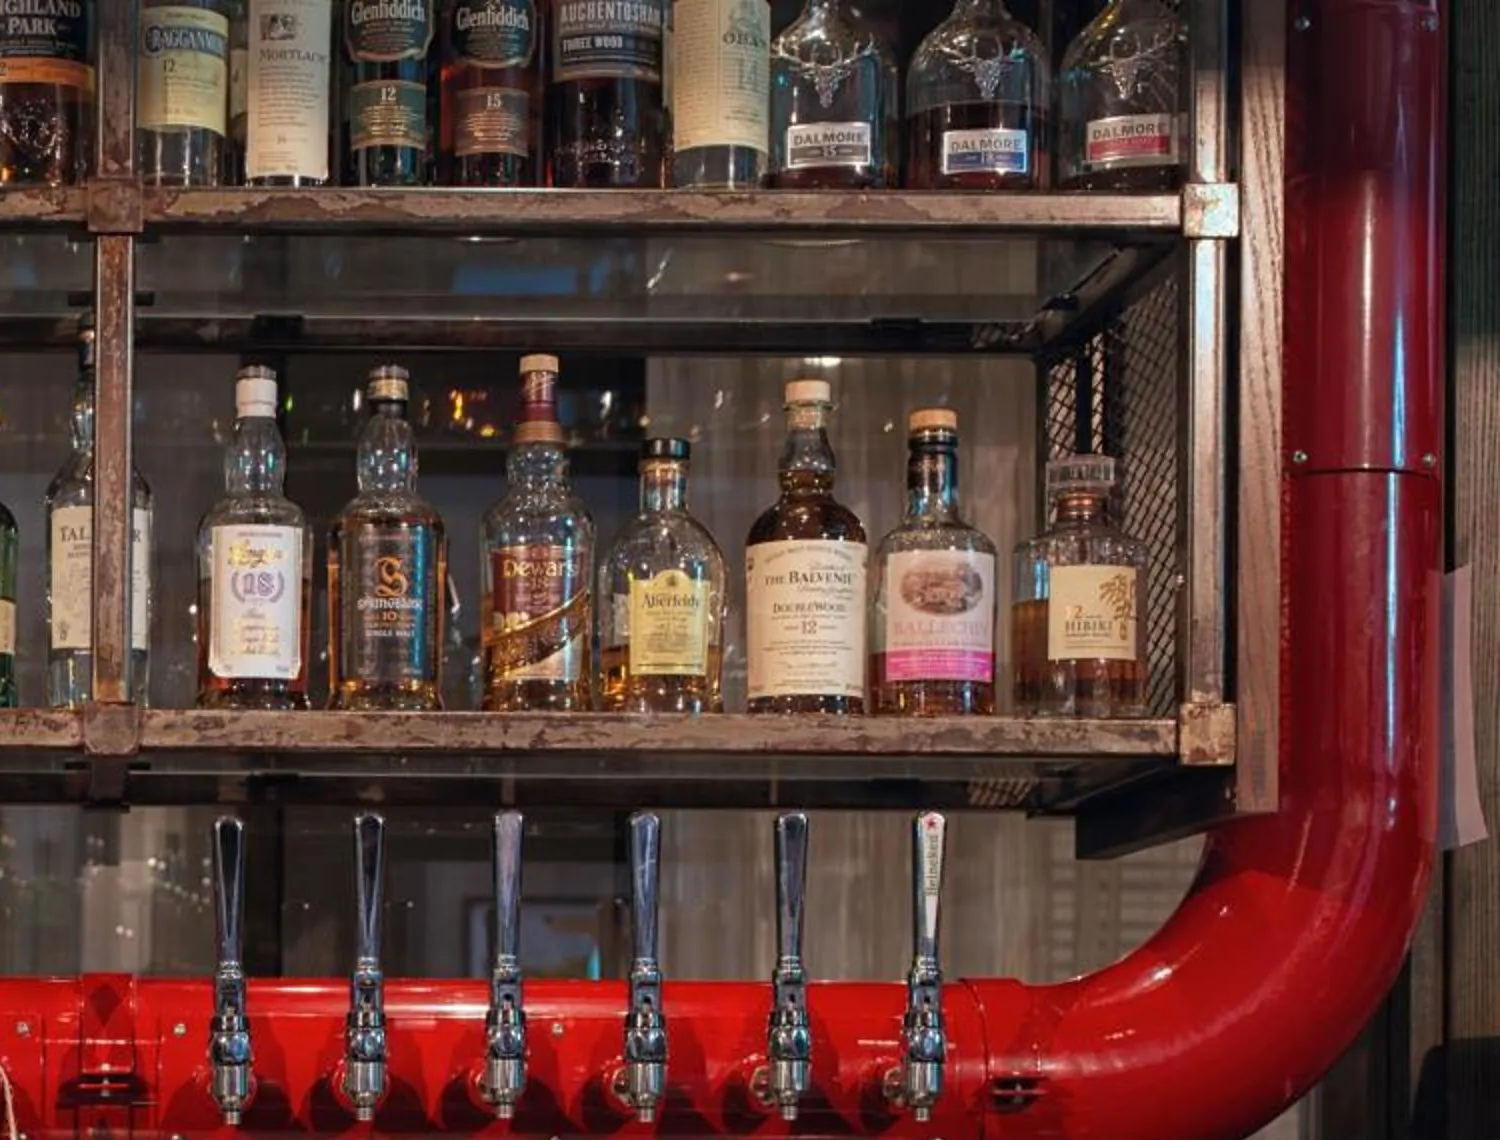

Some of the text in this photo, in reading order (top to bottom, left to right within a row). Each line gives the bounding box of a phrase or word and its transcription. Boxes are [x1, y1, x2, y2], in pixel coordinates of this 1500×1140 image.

[457, 2, 529, 30] Glenfiddich
[560, 0, 661, 23] AUCHENTOSHAN
[6, 17, 56, 36] PARK
[163, 59, 177, 73] 12
[381, 87, 396, 100] 12
[1093, 122, 1169, 139] DALMORE
[794, 132, 864, 146] DALMORE
[951, 138, 1023, 151] DALMORE
[383, 611, 397, 621] 10
[801, 621, 817, 635] 12
[1065, 621, 1112, 632] HIBIKI
